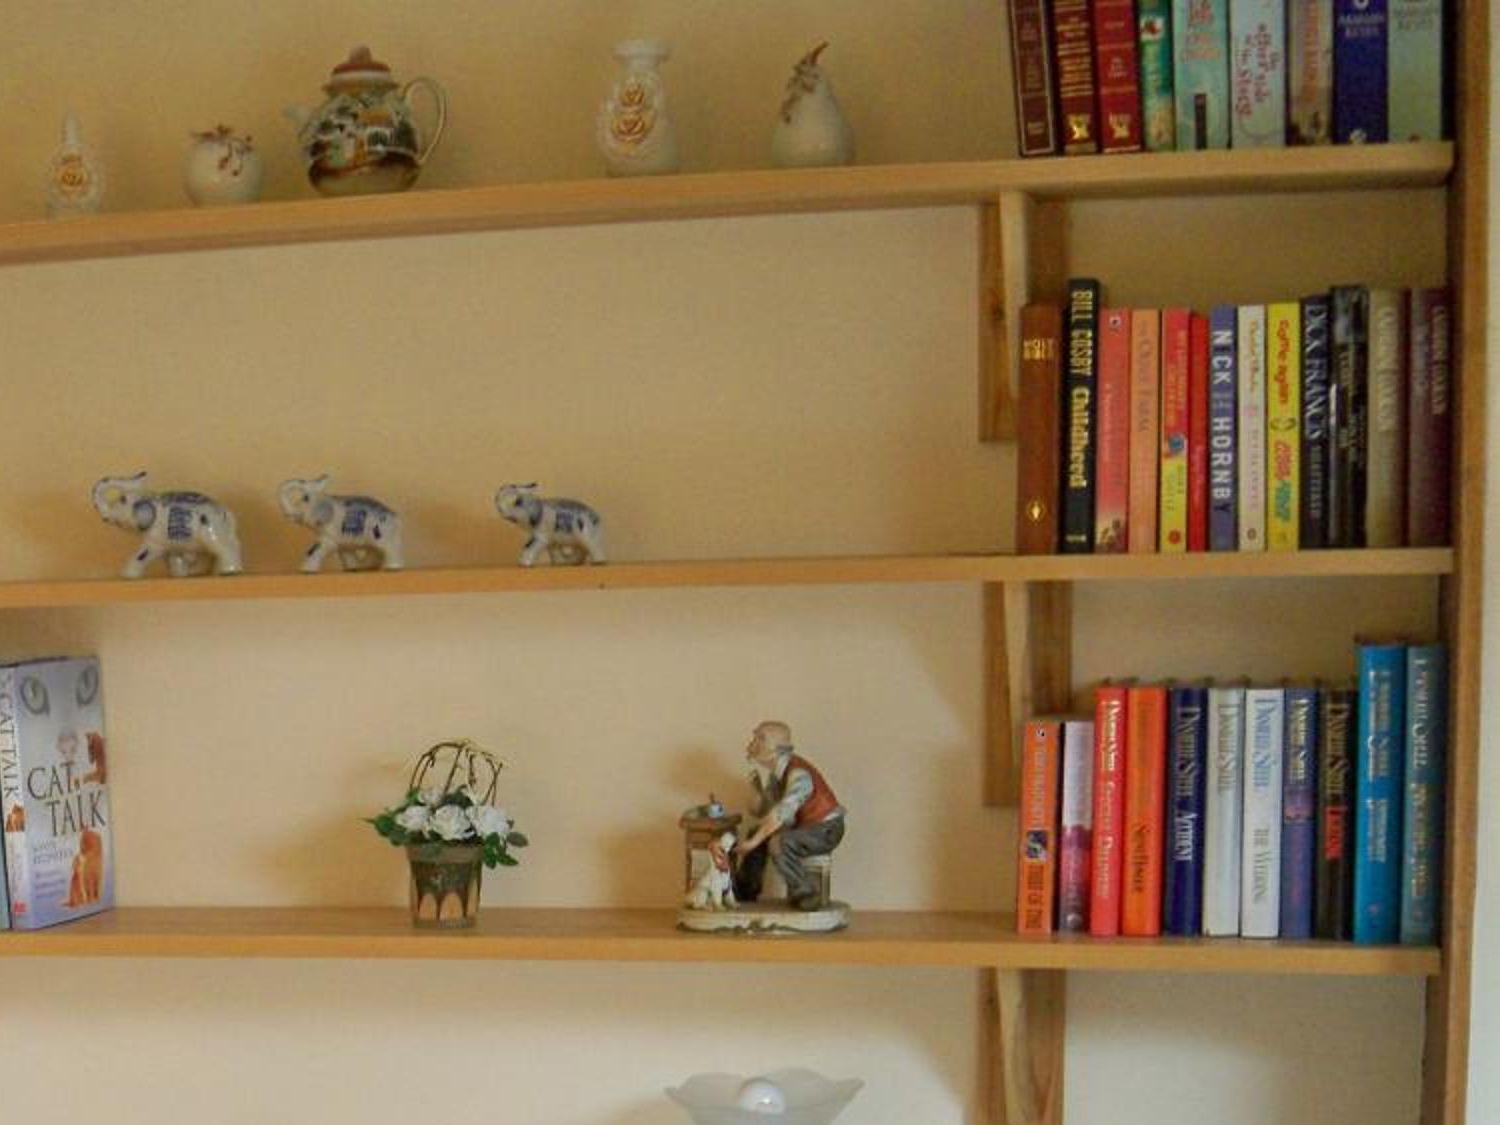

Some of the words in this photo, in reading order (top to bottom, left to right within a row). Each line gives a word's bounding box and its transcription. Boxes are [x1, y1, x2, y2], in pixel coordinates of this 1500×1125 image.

[1071, 289, 1093, 323] BILL
[1305, 304, 1328, 353] DICK
[1070, 328, 1093, 377] COSBY
[1212, 330, 1232, 385] NICK
[1304, 358, 1326, 440] FRANCIS
[1068, 386, 1090, 488] Childhood
[1211, 416, 1232, 513] HORNBY
[1176, 708, 1201, 761] DANIELLE
[1219, 704, 1240, 757] DANIELLE
[1253, 698, 1278, 751] DANIELLE
[1291, 699, 1310, 746] DANIELLE
[1325, 703, 1351, 756] DANIELLE
[1, 747, 19, 800] TALK
[27, 759, 75, 800] CAT
[1176, 761, 1197, 800] STEEL
[1218, 757, 1238, 794] STEEL
[1253, 752, 1277, 789] STEEL
[1290, 749, 1308, 784] STEEL
[1325, 758, 1348, 798] STEEL
[45, 789, 106, 837] TALK
[1174, 808, 1200, 863] ACCIDENT
[1255, 828, 1270, 846] THE
[1254, 852, 1272, 904] WEDDING
